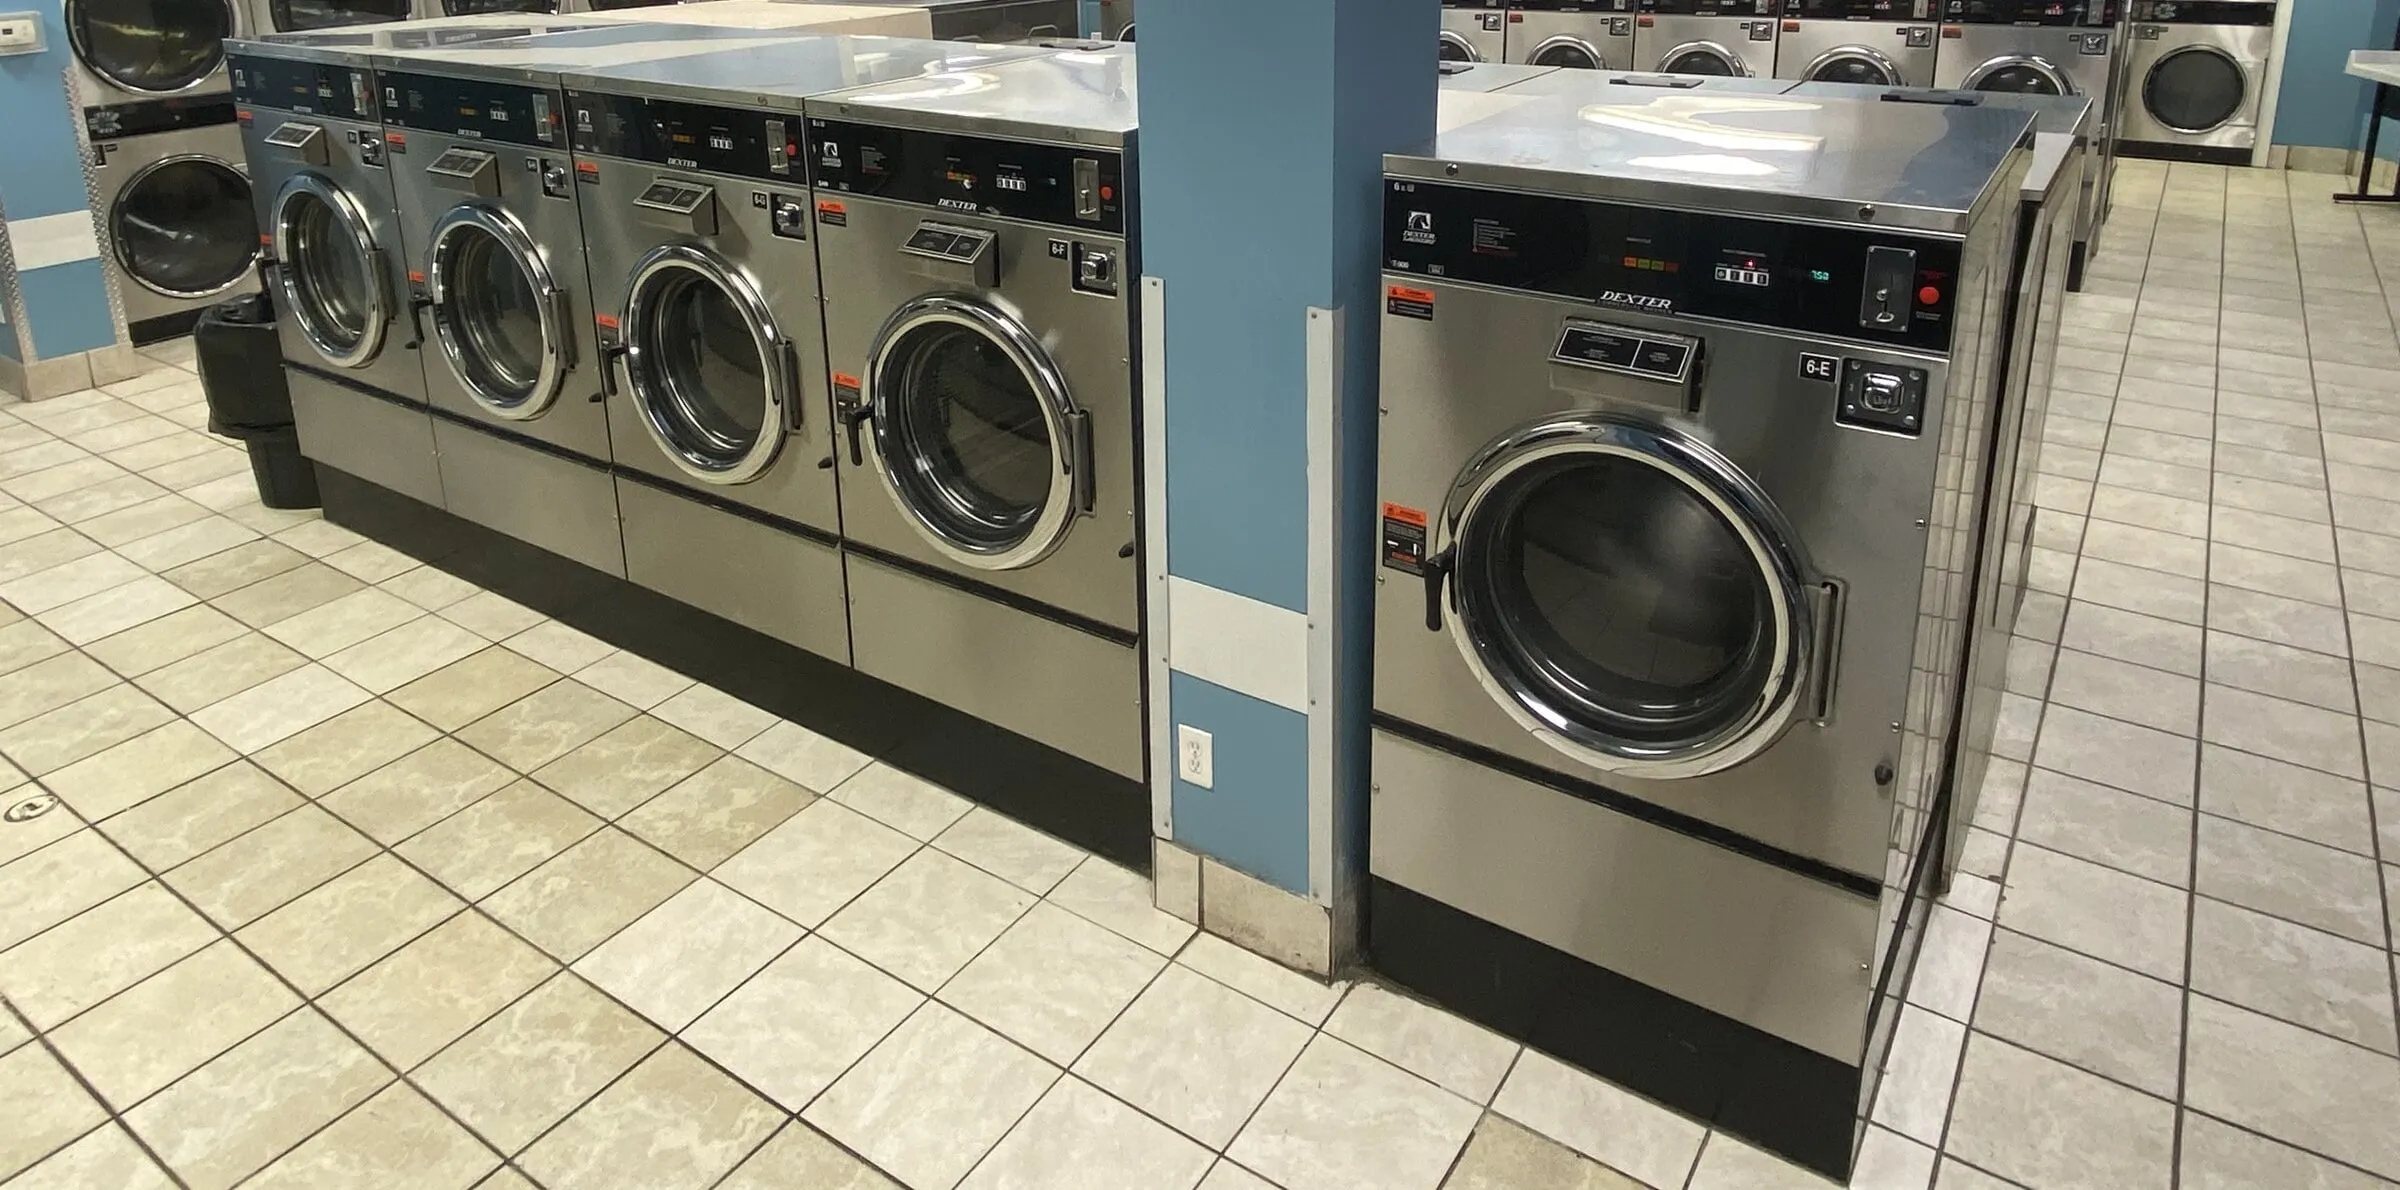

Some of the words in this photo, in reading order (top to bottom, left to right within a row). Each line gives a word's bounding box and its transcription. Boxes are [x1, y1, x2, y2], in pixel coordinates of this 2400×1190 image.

[938, 198, 977, 211] DEXTER
[1052, 243, 1065, 255] 6-F
[1600, 290, 1672, 309] DEXTER
[1806, 359, 1831, 377] 6-E
